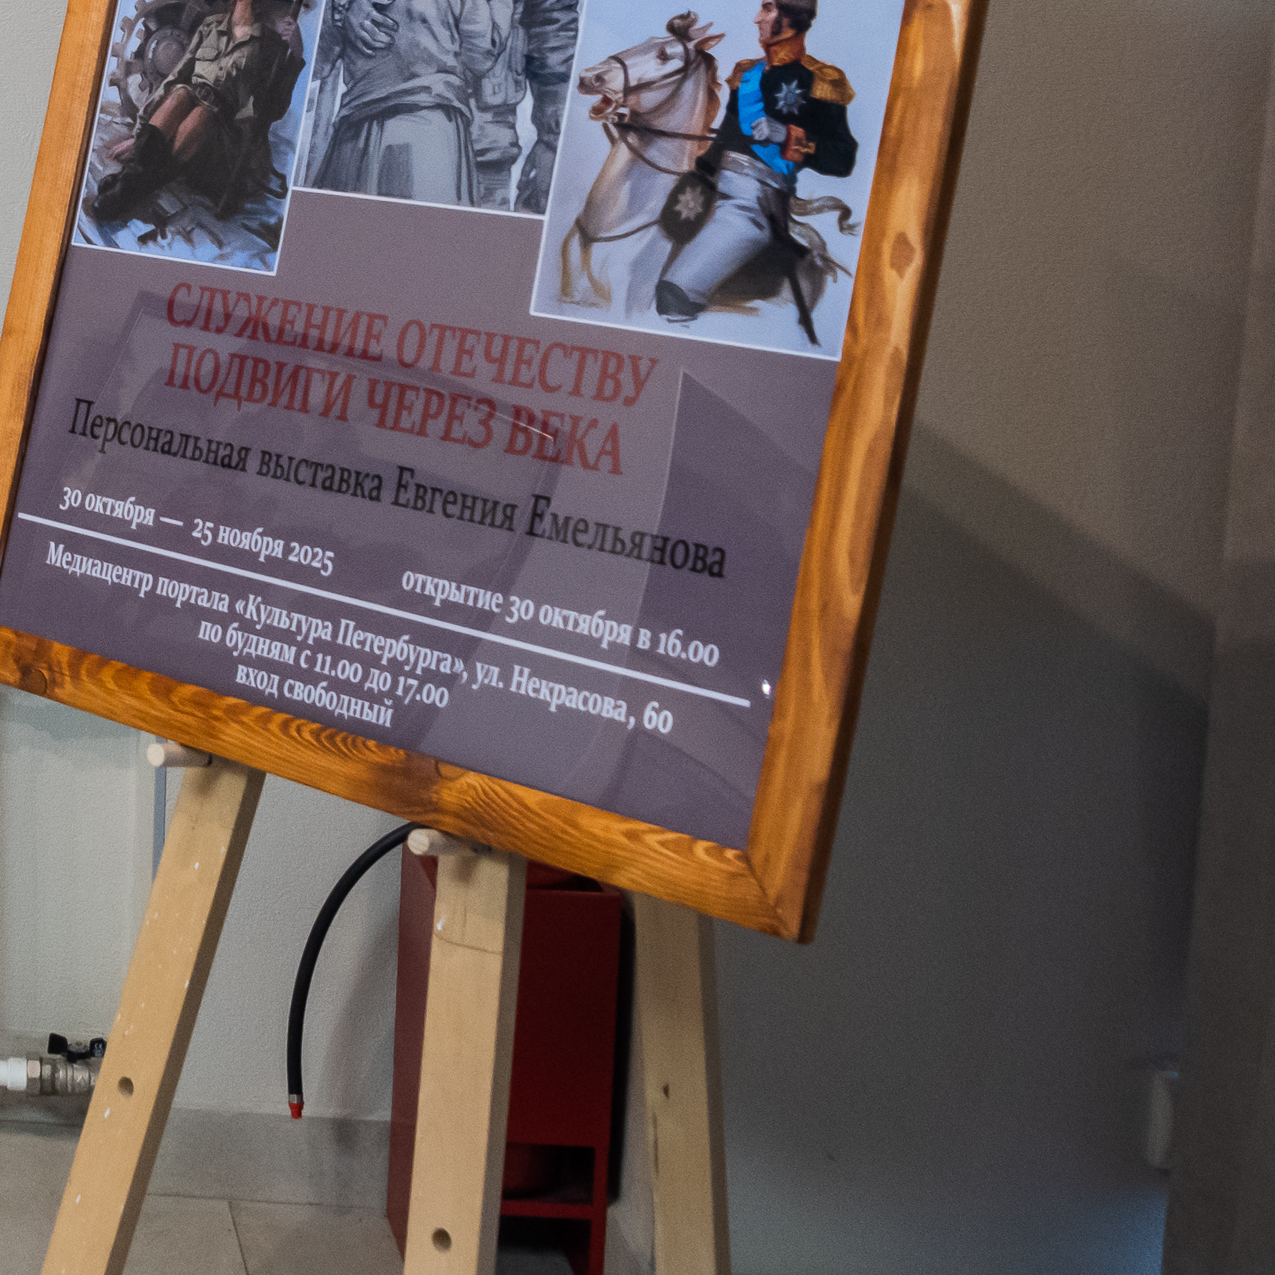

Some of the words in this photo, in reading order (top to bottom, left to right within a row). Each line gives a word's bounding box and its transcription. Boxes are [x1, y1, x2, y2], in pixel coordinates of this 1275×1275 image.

[166, 282, 388, 363] СЛУЖЕНИЕ
[396, 319, 659, 407] ОТЕЧЕСТВУ
[164, 342, 357, 423] ПОДВИГИ
[366, 377, 497, 449] ЧЕРЕЗ
[504, 403, 623, 476] ВЕКА
[59, 486, 82, 510] 30
[85, 496, 156, 529] октября
[192, 518, 214, 546] 25
[217, 524, 284, 562] ноября
[288, 542, 335, 576] 2025
[68, 397, 251, 473] Персональная
[256, 449, 383, 503] выставка
[391, 465, 519, 532] Евгения
[525, 493, 727, 578] Емельянова
[46, 541, 153, 597] Медиацентр
[156, 576, 229, 614] портала
[235, 594, 333, 644] «Культура
[335, 618, 468, 683] Петербурга»,
[472, 660, 503, 689] ул.
[509, 664, 636, 730] Некрасова,
[643, 701, 673, 734] 60
[199, 621, 222, 644] по
[225, 622, 296, 664] будням
[300, 649, 312, 668] с
[313, 651, 362, 684] 11.00
[365, 668, 392, 693] до
[396, 677, 449, 709] 17.00
[402, 570, 503, 613] открытие
[505, 595, 535, 624] 30
[538, 603, 633, 649] октября
[637, 627, 651, 650] в
[656, 628, 720, 668] 16.00
[235, 664, 279, 695] вход
[283, 680, 395, 727] свободный
